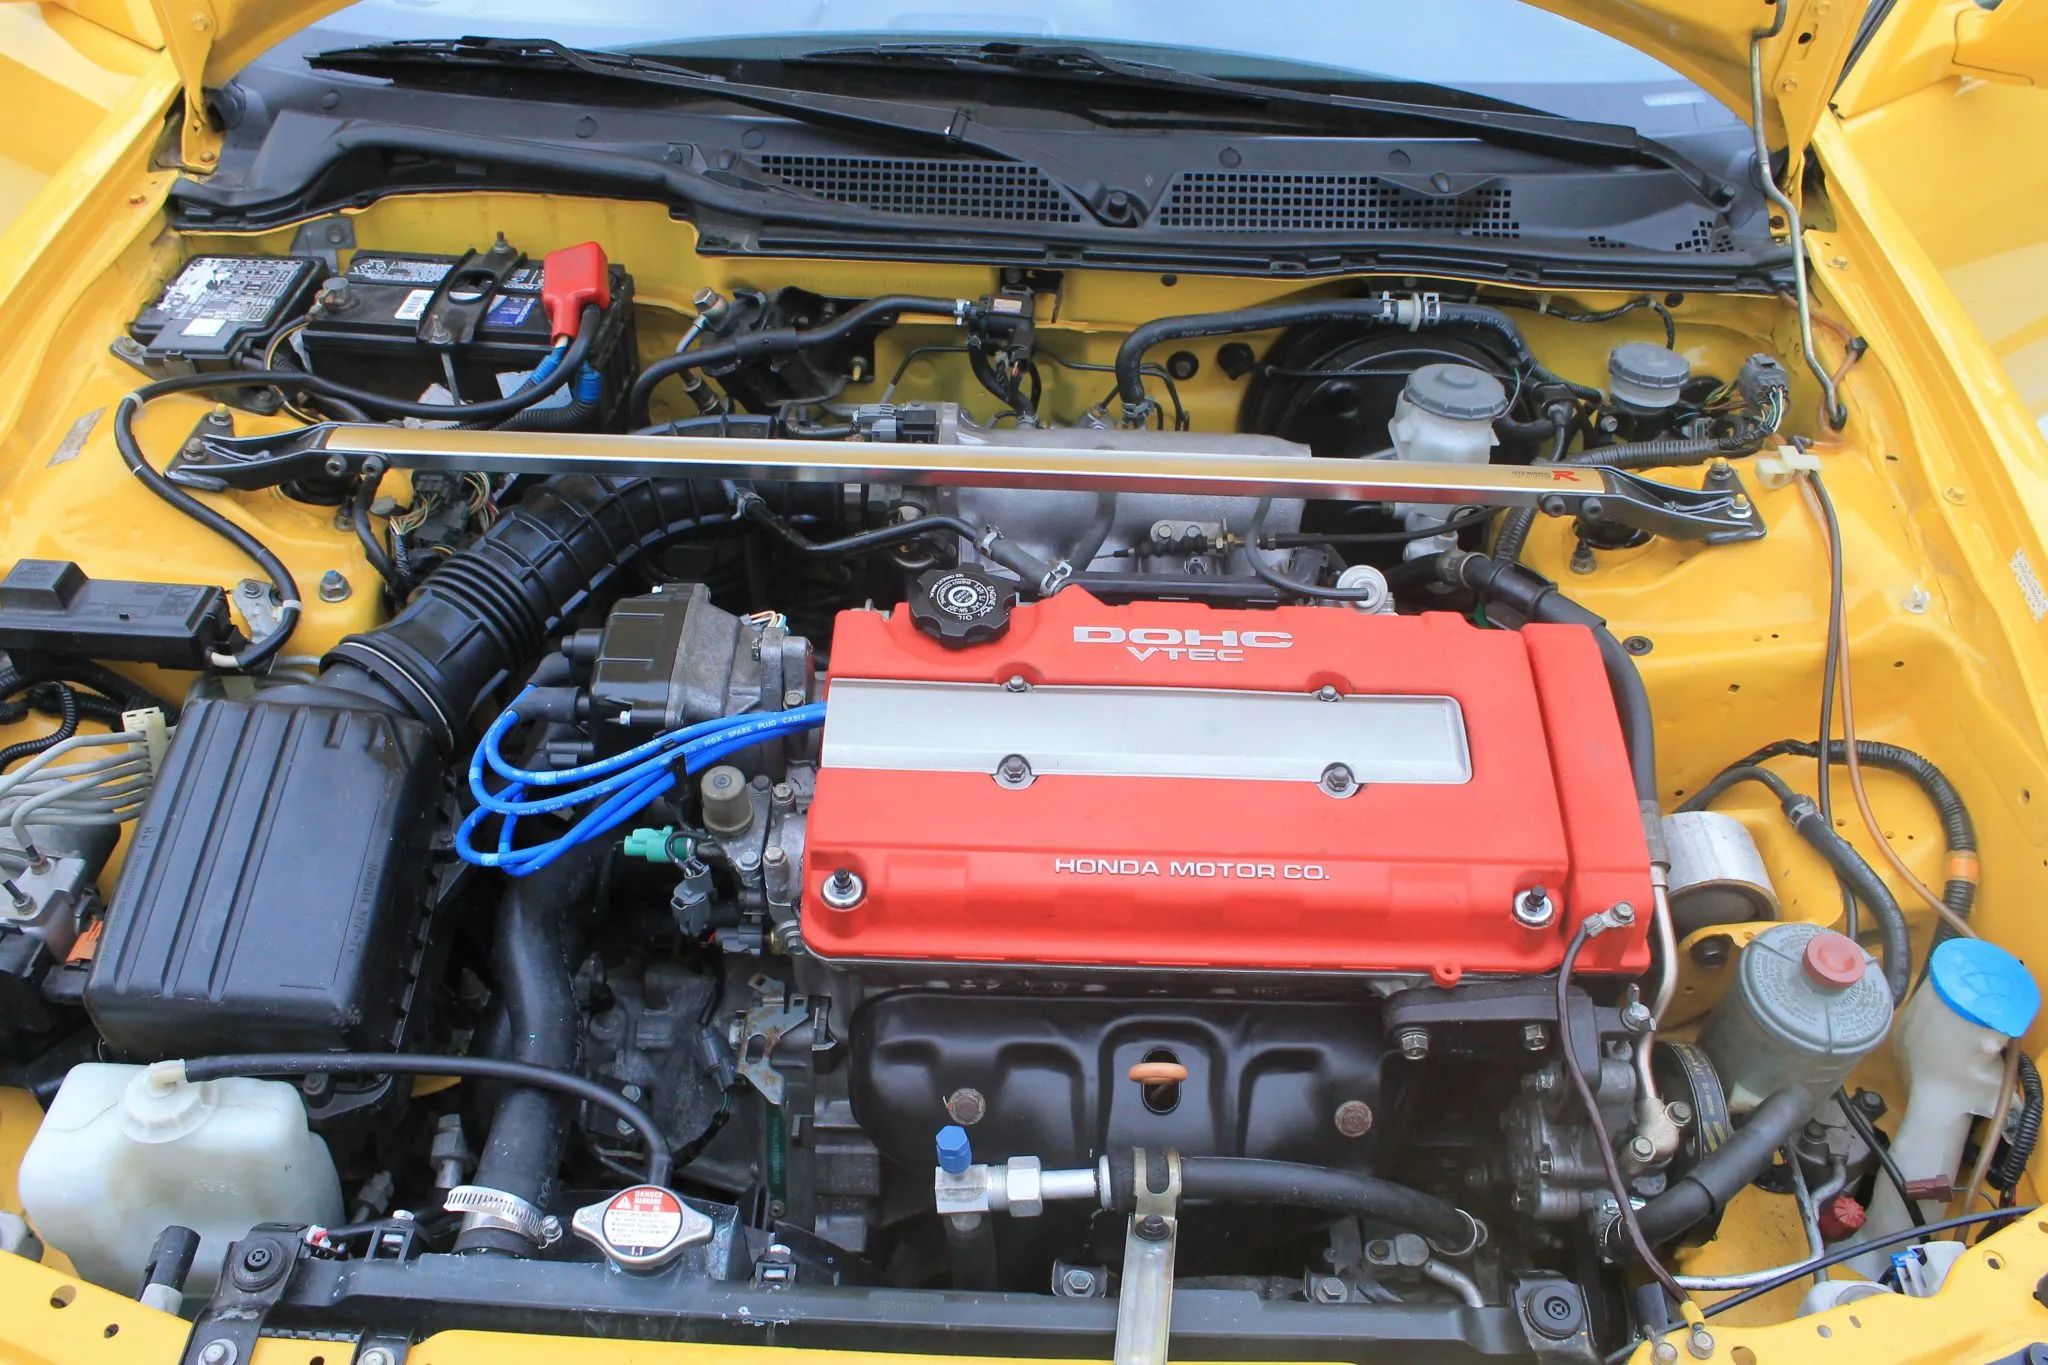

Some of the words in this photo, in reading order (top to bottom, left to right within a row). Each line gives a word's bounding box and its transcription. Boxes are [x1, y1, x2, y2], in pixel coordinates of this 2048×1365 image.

[1552, 470, 1581, 482] R
[986, 585, 997, 607] ENGINE
[1073, 626, 1294, 649] DOHC
[1126, 645, 1244, 662] VTEC
[728, 726, 753, 739] SPARK
[757, 719, 777, 730] PLUG
[783, 714, 807, 726] CABLE
[583, 759, 610, 773] SPARK
[614, 750, 634, 763] PLUG
[1055, 858, 1160, 876] HONDA
[1170, 861, 1276, 879] MOTOR
[1283, 863, 1331, 881] CO.
[634, 1190, 664, 1199] DANGER
[631, 1246, 644, 1256] 1.1
